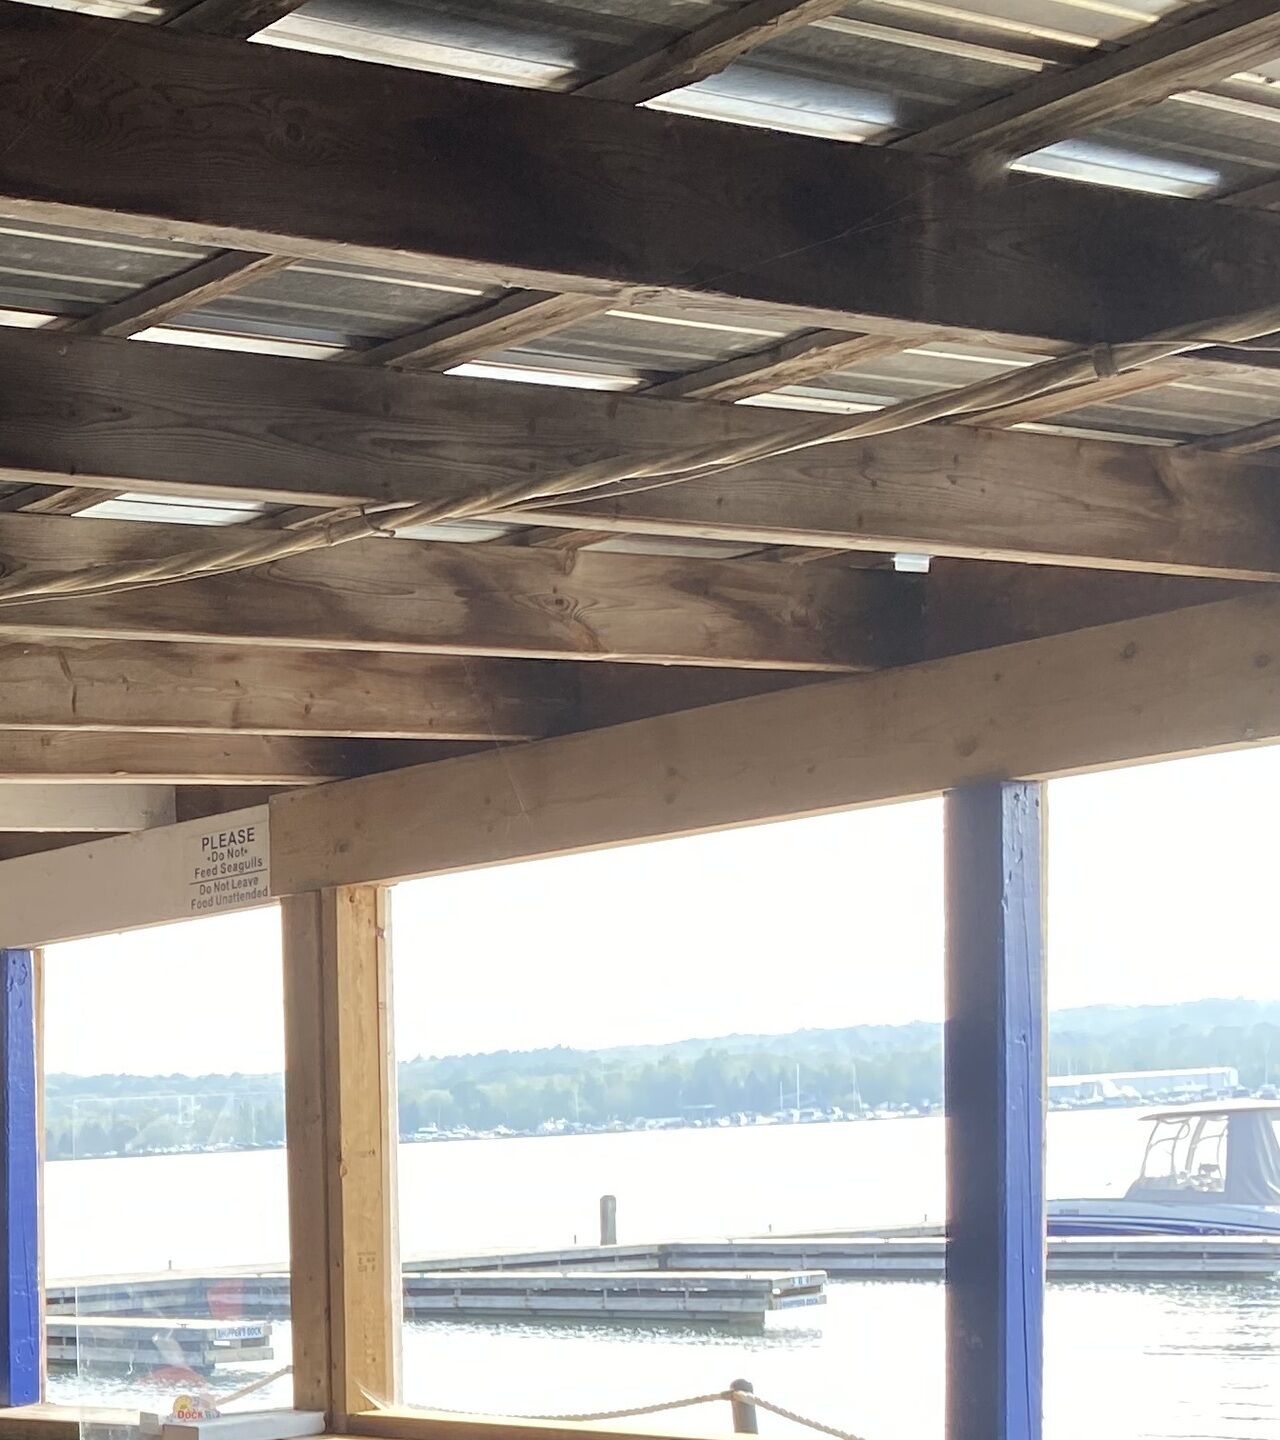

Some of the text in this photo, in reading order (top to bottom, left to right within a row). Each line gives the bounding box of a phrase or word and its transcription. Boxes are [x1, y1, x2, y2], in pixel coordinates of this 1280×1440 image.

[202, 827, 255, 852] PLEASE
[194, 857, 263, 879] Feed Seagulls
[199, 876, 259, 895] Do Not Leave
[191, 887, 269, 910] Food Unattended
